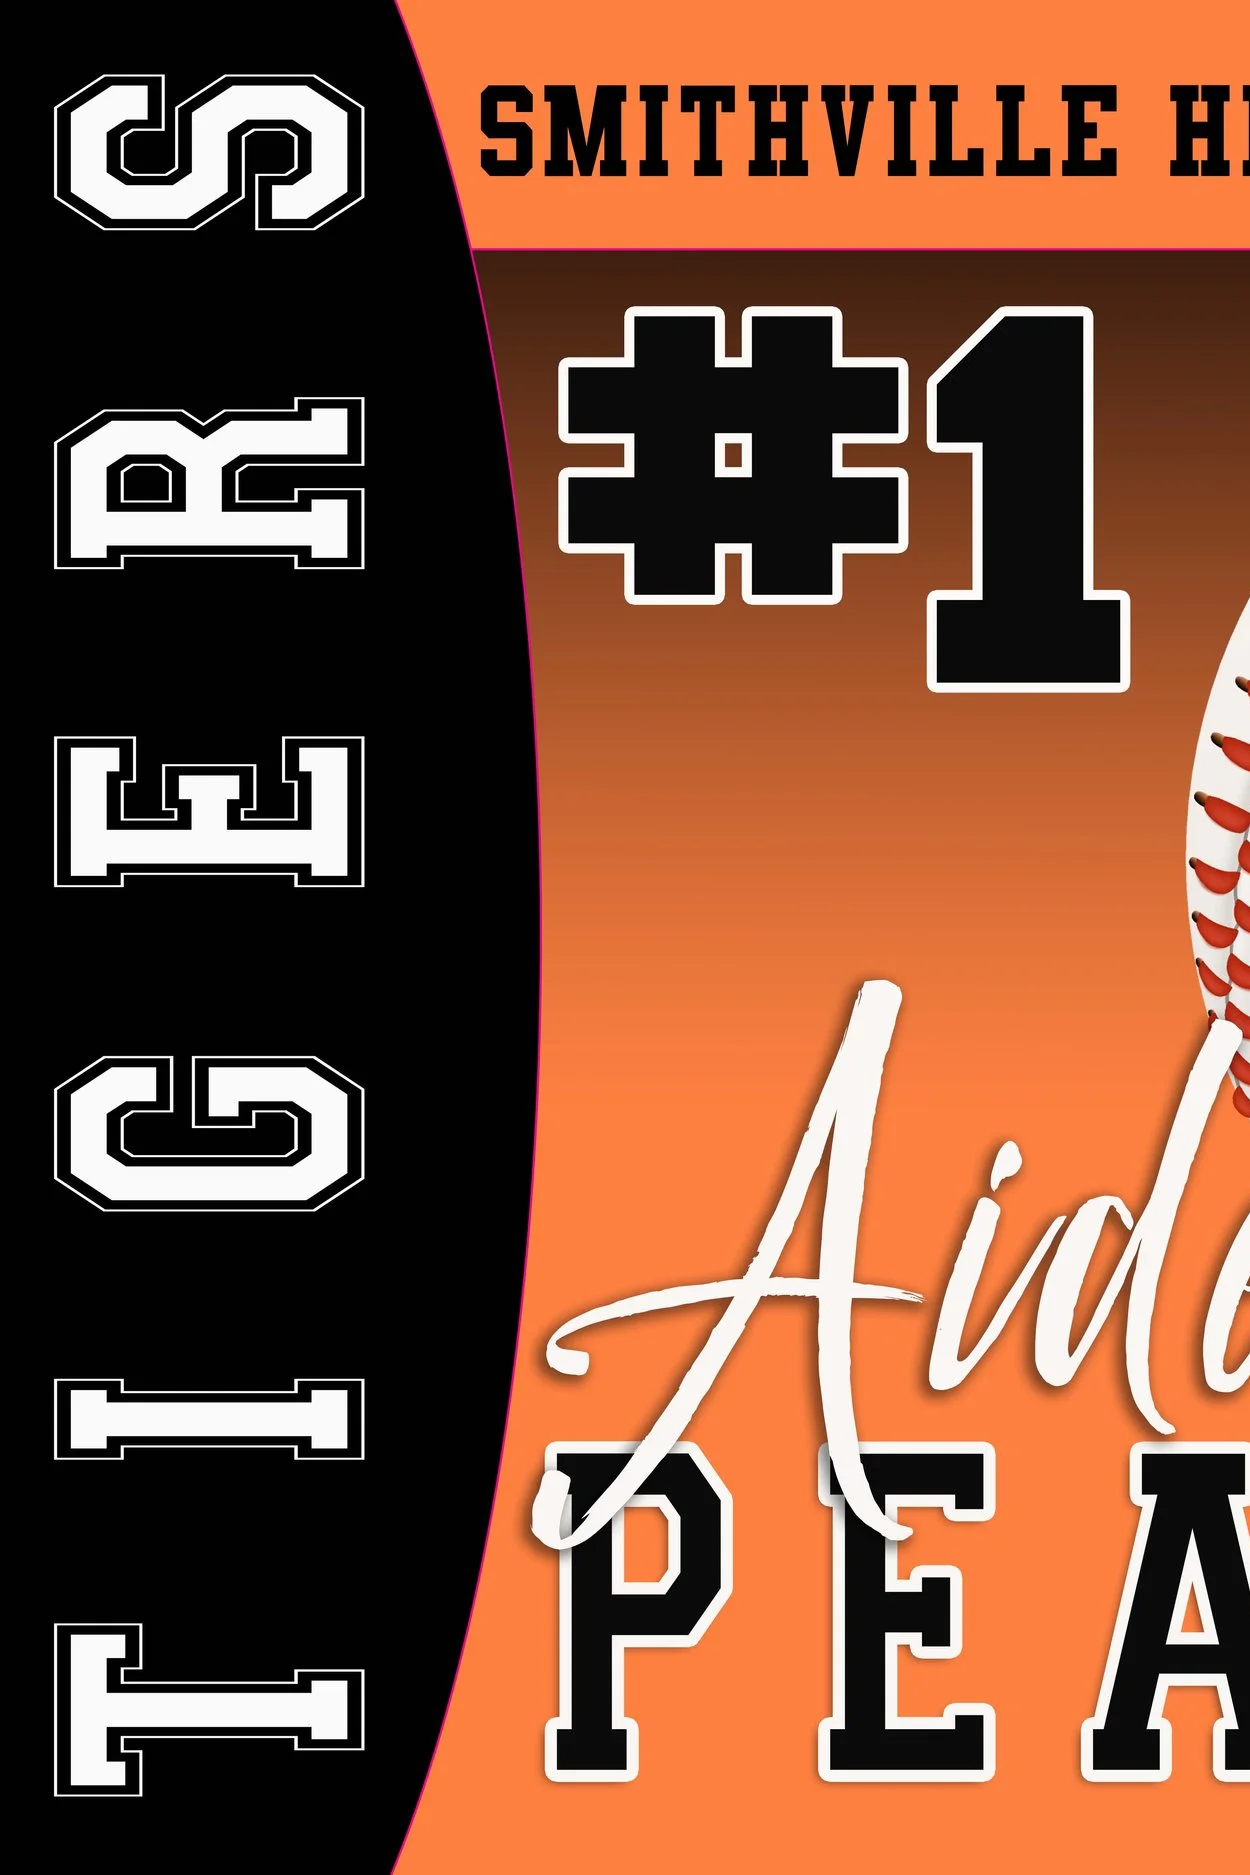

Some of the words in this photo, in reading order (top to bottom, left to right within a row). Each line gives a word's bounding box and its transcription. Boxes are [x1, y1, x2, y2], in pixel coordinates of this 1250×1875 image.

[481, 85, 1117, 176] SMITHVILLE
[559, 307, 1130, 692] #1
[54, 74, 365, 1797] TIGERS
